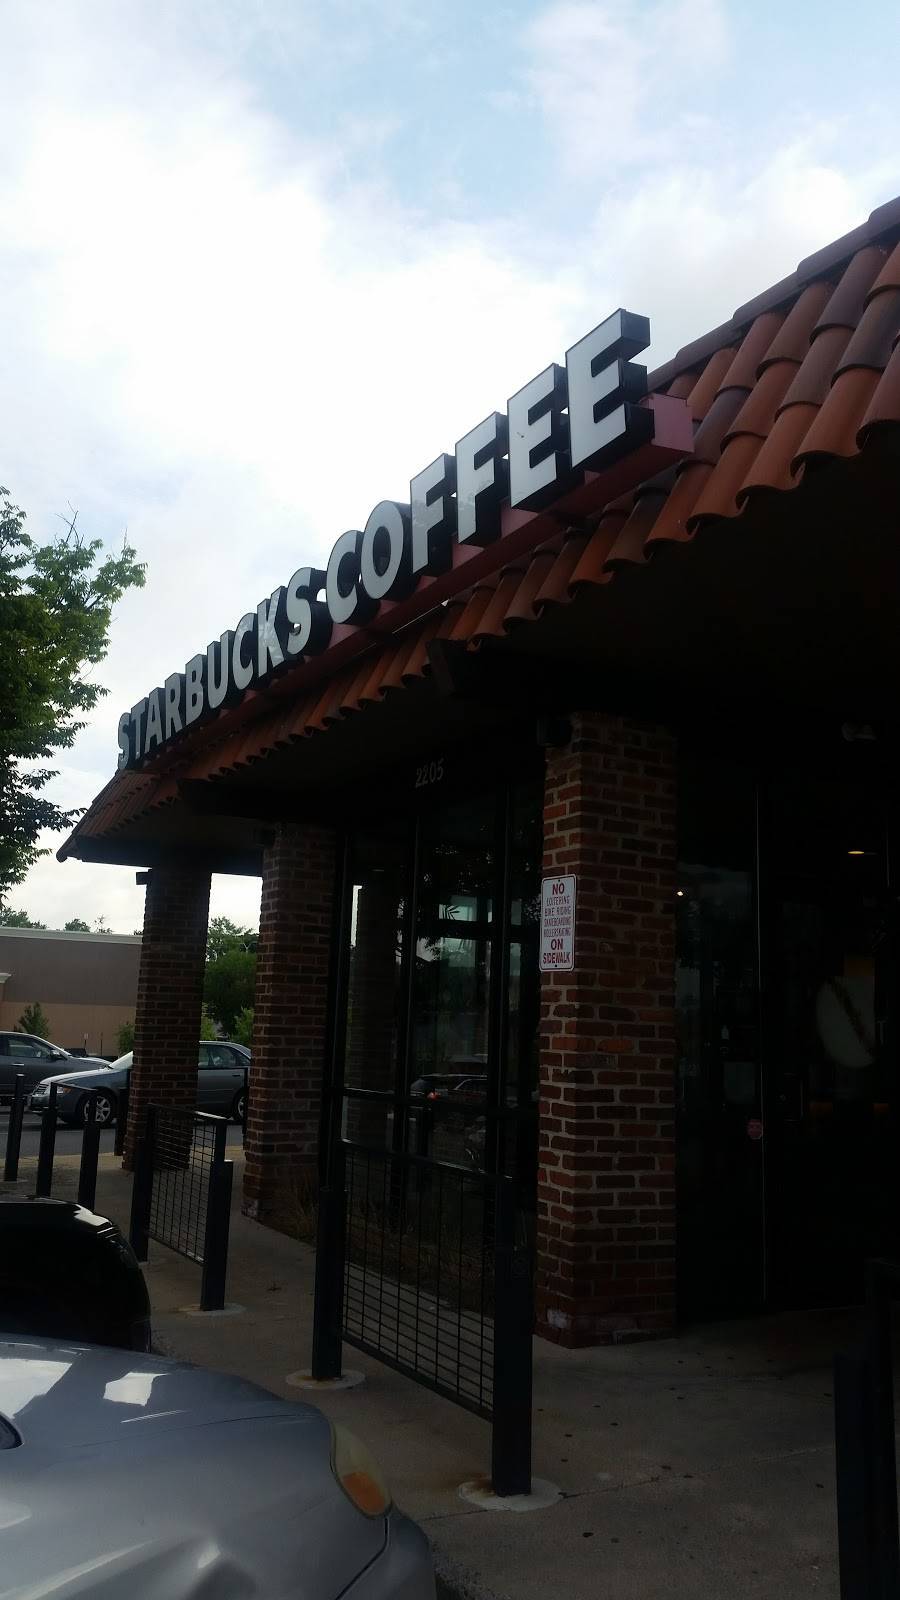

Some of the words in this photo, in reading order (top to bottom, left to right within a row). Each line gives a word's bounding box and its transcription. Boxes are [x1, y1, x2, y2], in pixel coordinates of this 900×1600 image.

[117, 567, 313, 770] STARBUCKS
[326, 308, 629, 624] COFFEE
[415, 757, 445, 788] 2205
[552, 883, 565, 895] NO
[550, 938, 563, 951] ON
[543, 951, 571, 964] SIDEWALK
